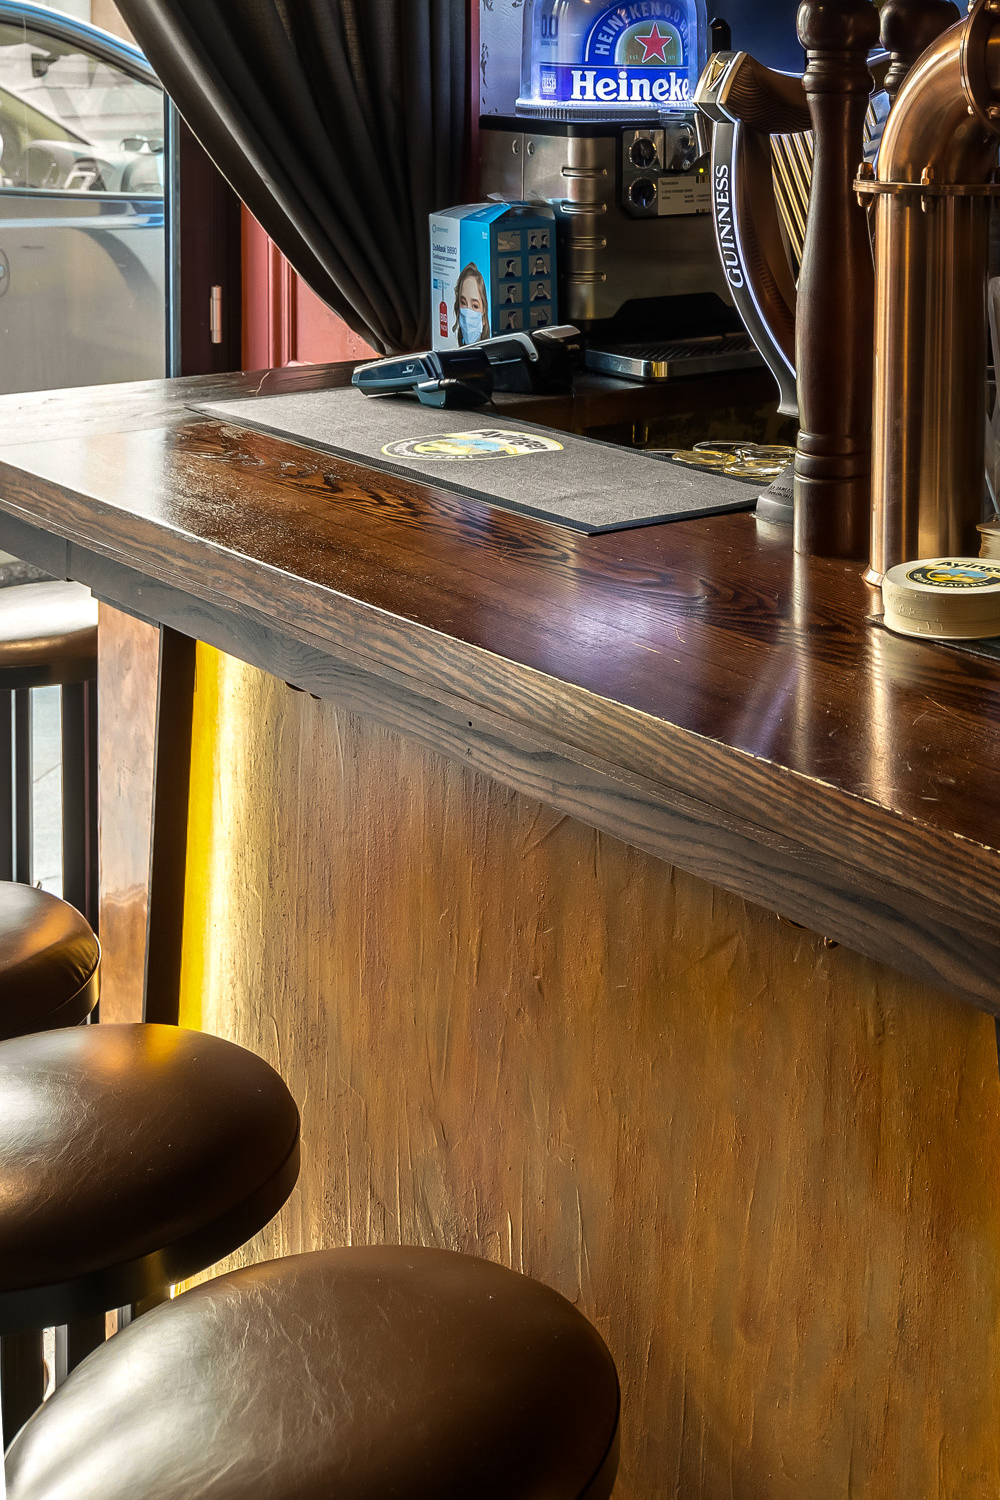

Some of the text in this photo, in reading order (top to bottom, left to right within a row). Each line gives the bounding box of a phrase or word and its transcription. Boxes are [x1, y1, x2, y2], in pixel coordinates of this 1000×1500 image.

[595, 1, 662, 56] HEINEKEN
[571, 70, 690, 101] Heineke
[715, 164, 744, 288] GUINNESS
